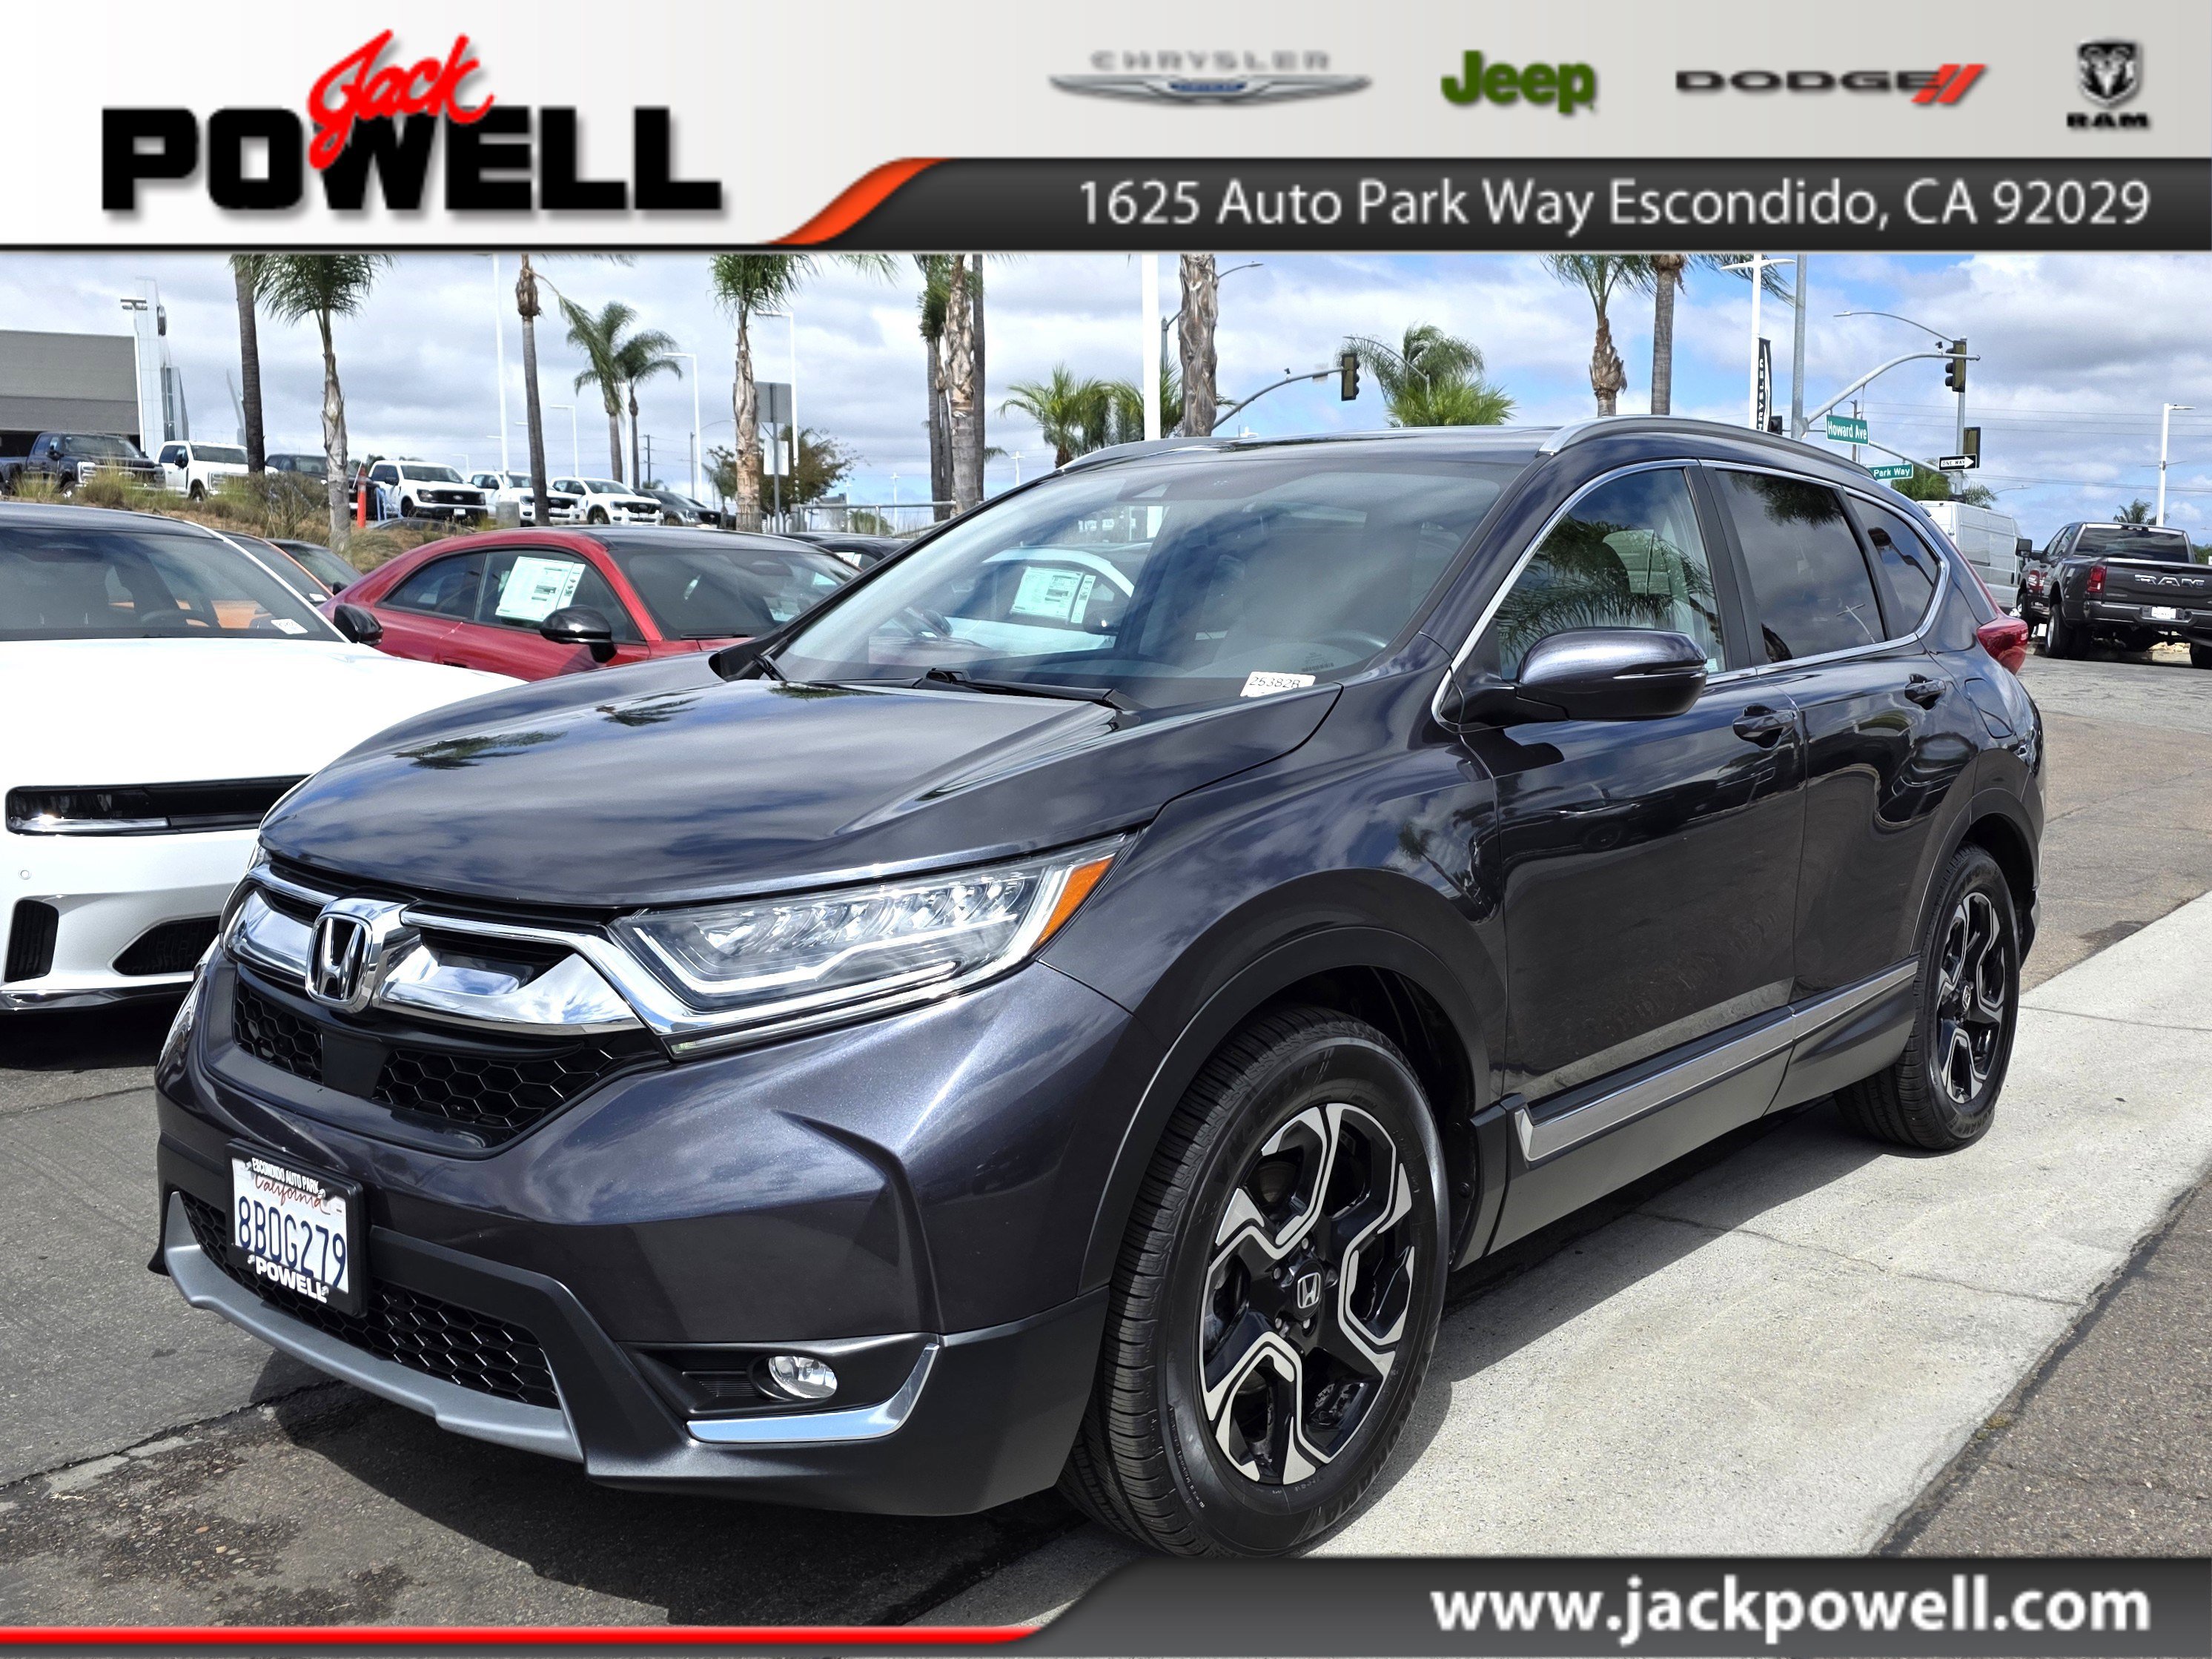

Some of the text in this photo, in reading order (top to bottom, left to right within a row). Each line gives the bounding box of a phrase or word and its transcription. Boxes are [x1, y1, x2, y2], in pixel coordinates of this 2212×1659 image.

[1827, 420, 1867, 440] Howard Ave
[1873, 467, 1910, 477] Park Way
[2134, 574, 2205, 589] RAM
[285, 1170, 302, 1189] AUTO
[302, 1176, 319, 1194] PARK
[254, 1256, 328, 1304] POWELL
